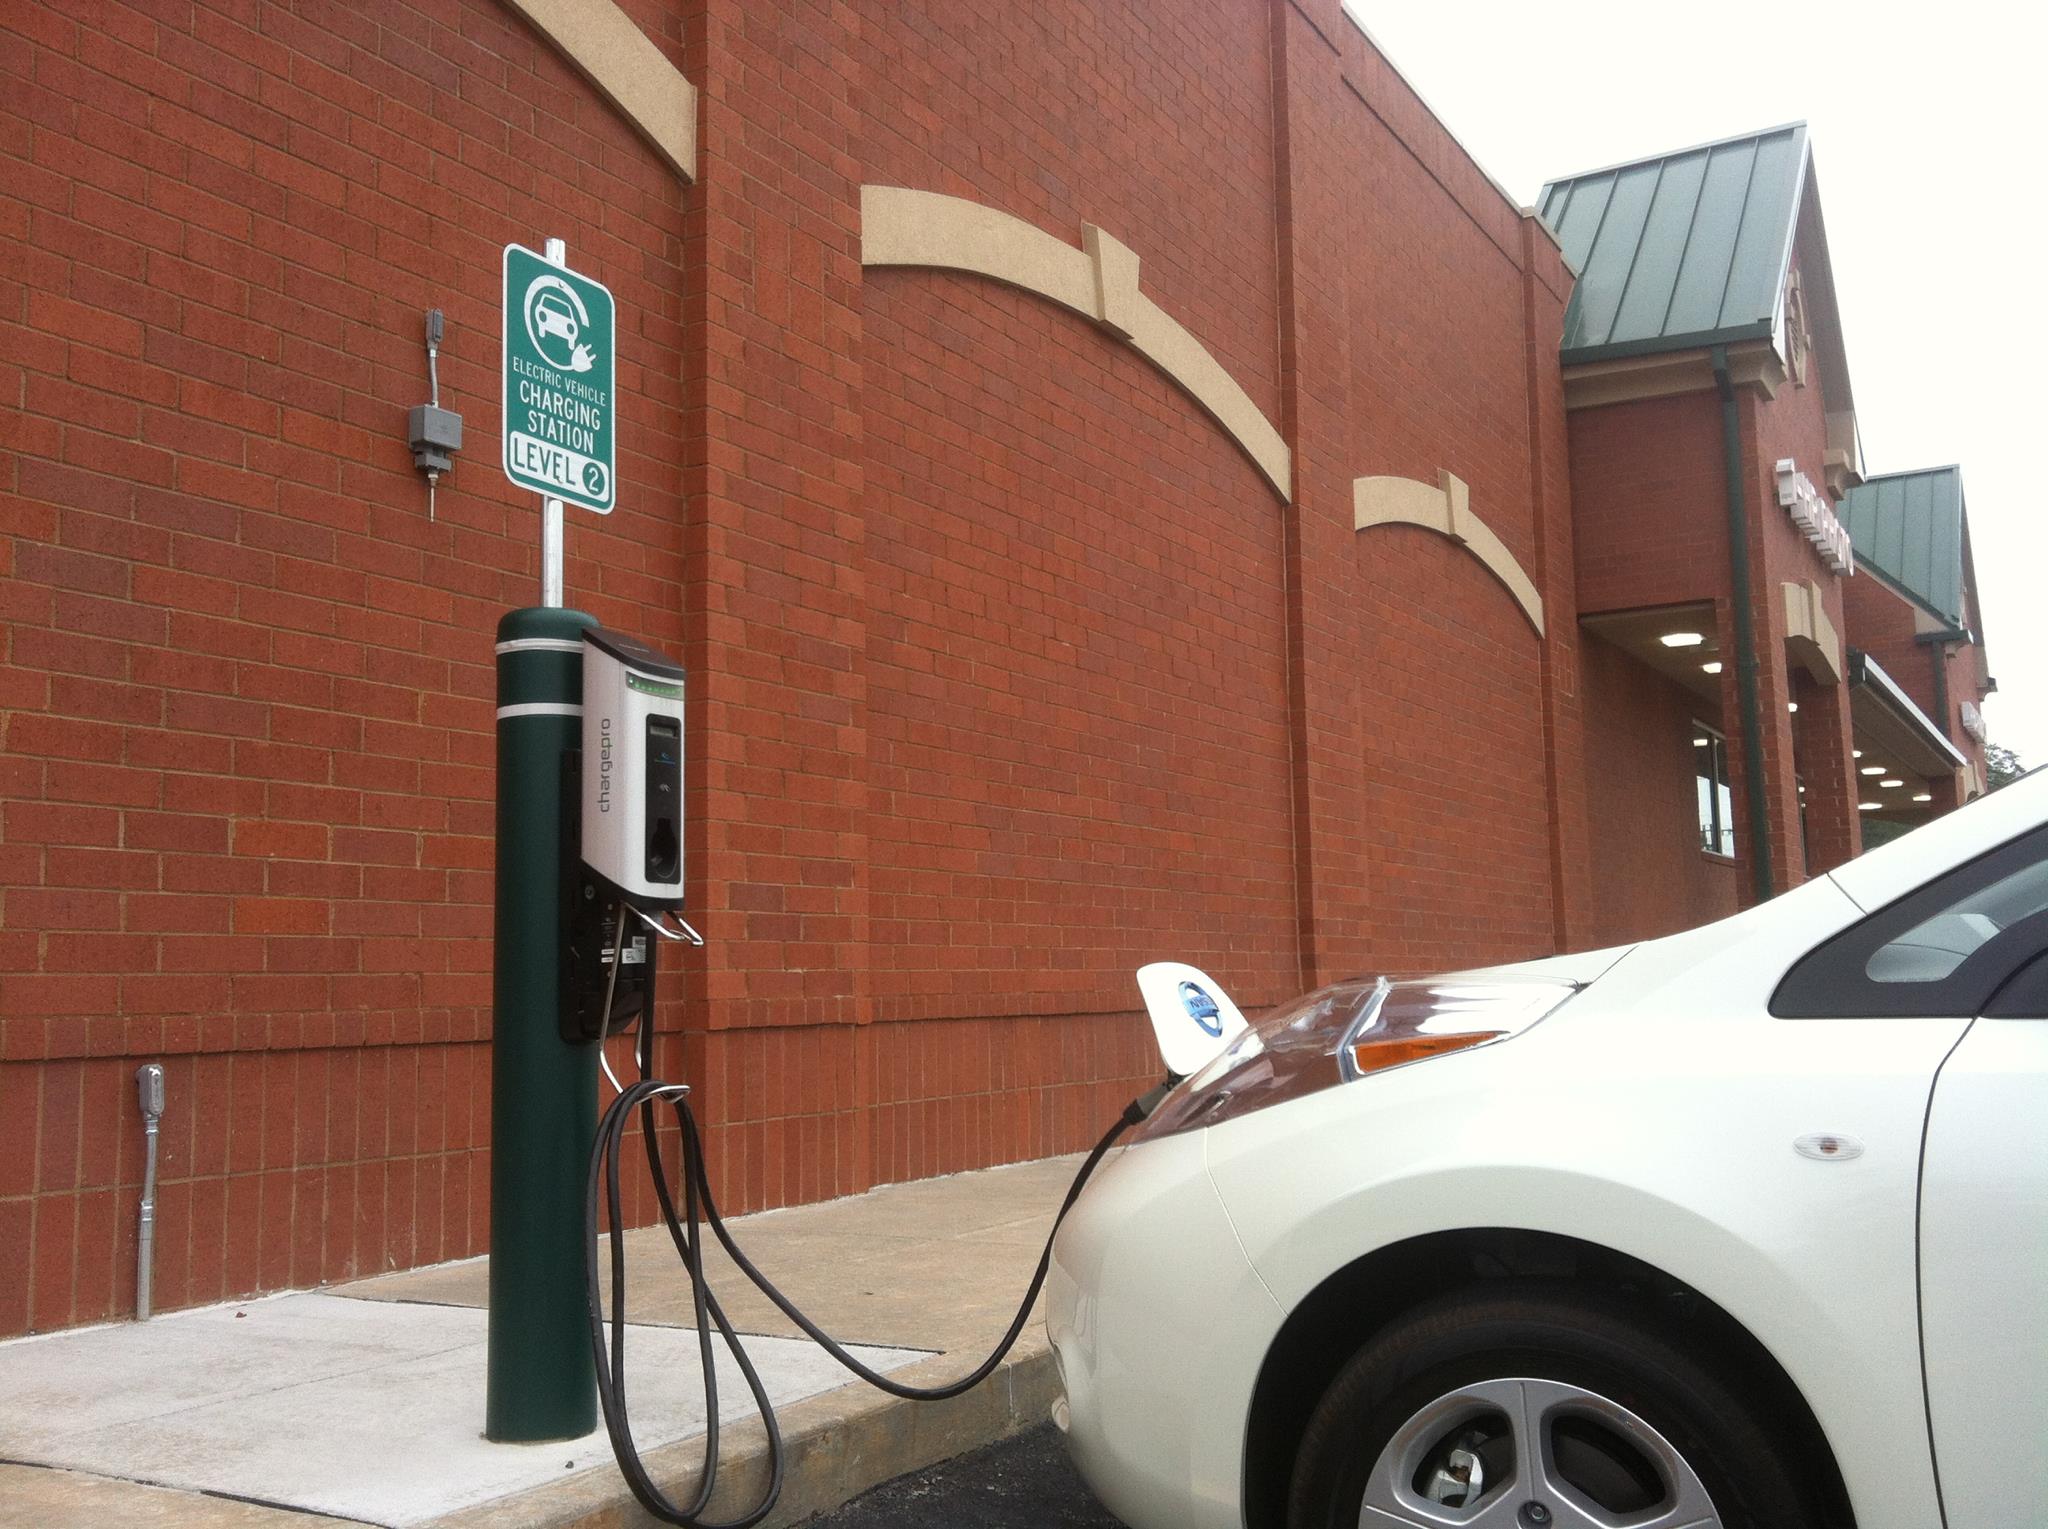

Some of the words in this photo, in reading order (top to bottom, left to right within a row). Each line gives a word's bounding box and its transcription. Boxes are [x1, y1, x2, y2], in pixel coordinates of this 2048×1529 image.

[513, 356, 562, 388] ELECTRIC
[564, 377, 606, 407] VEHICLE
[519, 380, 600, 431] CHARGING
[527, 409, 594, 454] STATION
[514, 437, 576, 486] LEVEL
[588, 466, 599, 492] 2
[597, 718, 613, 813] chargepro
